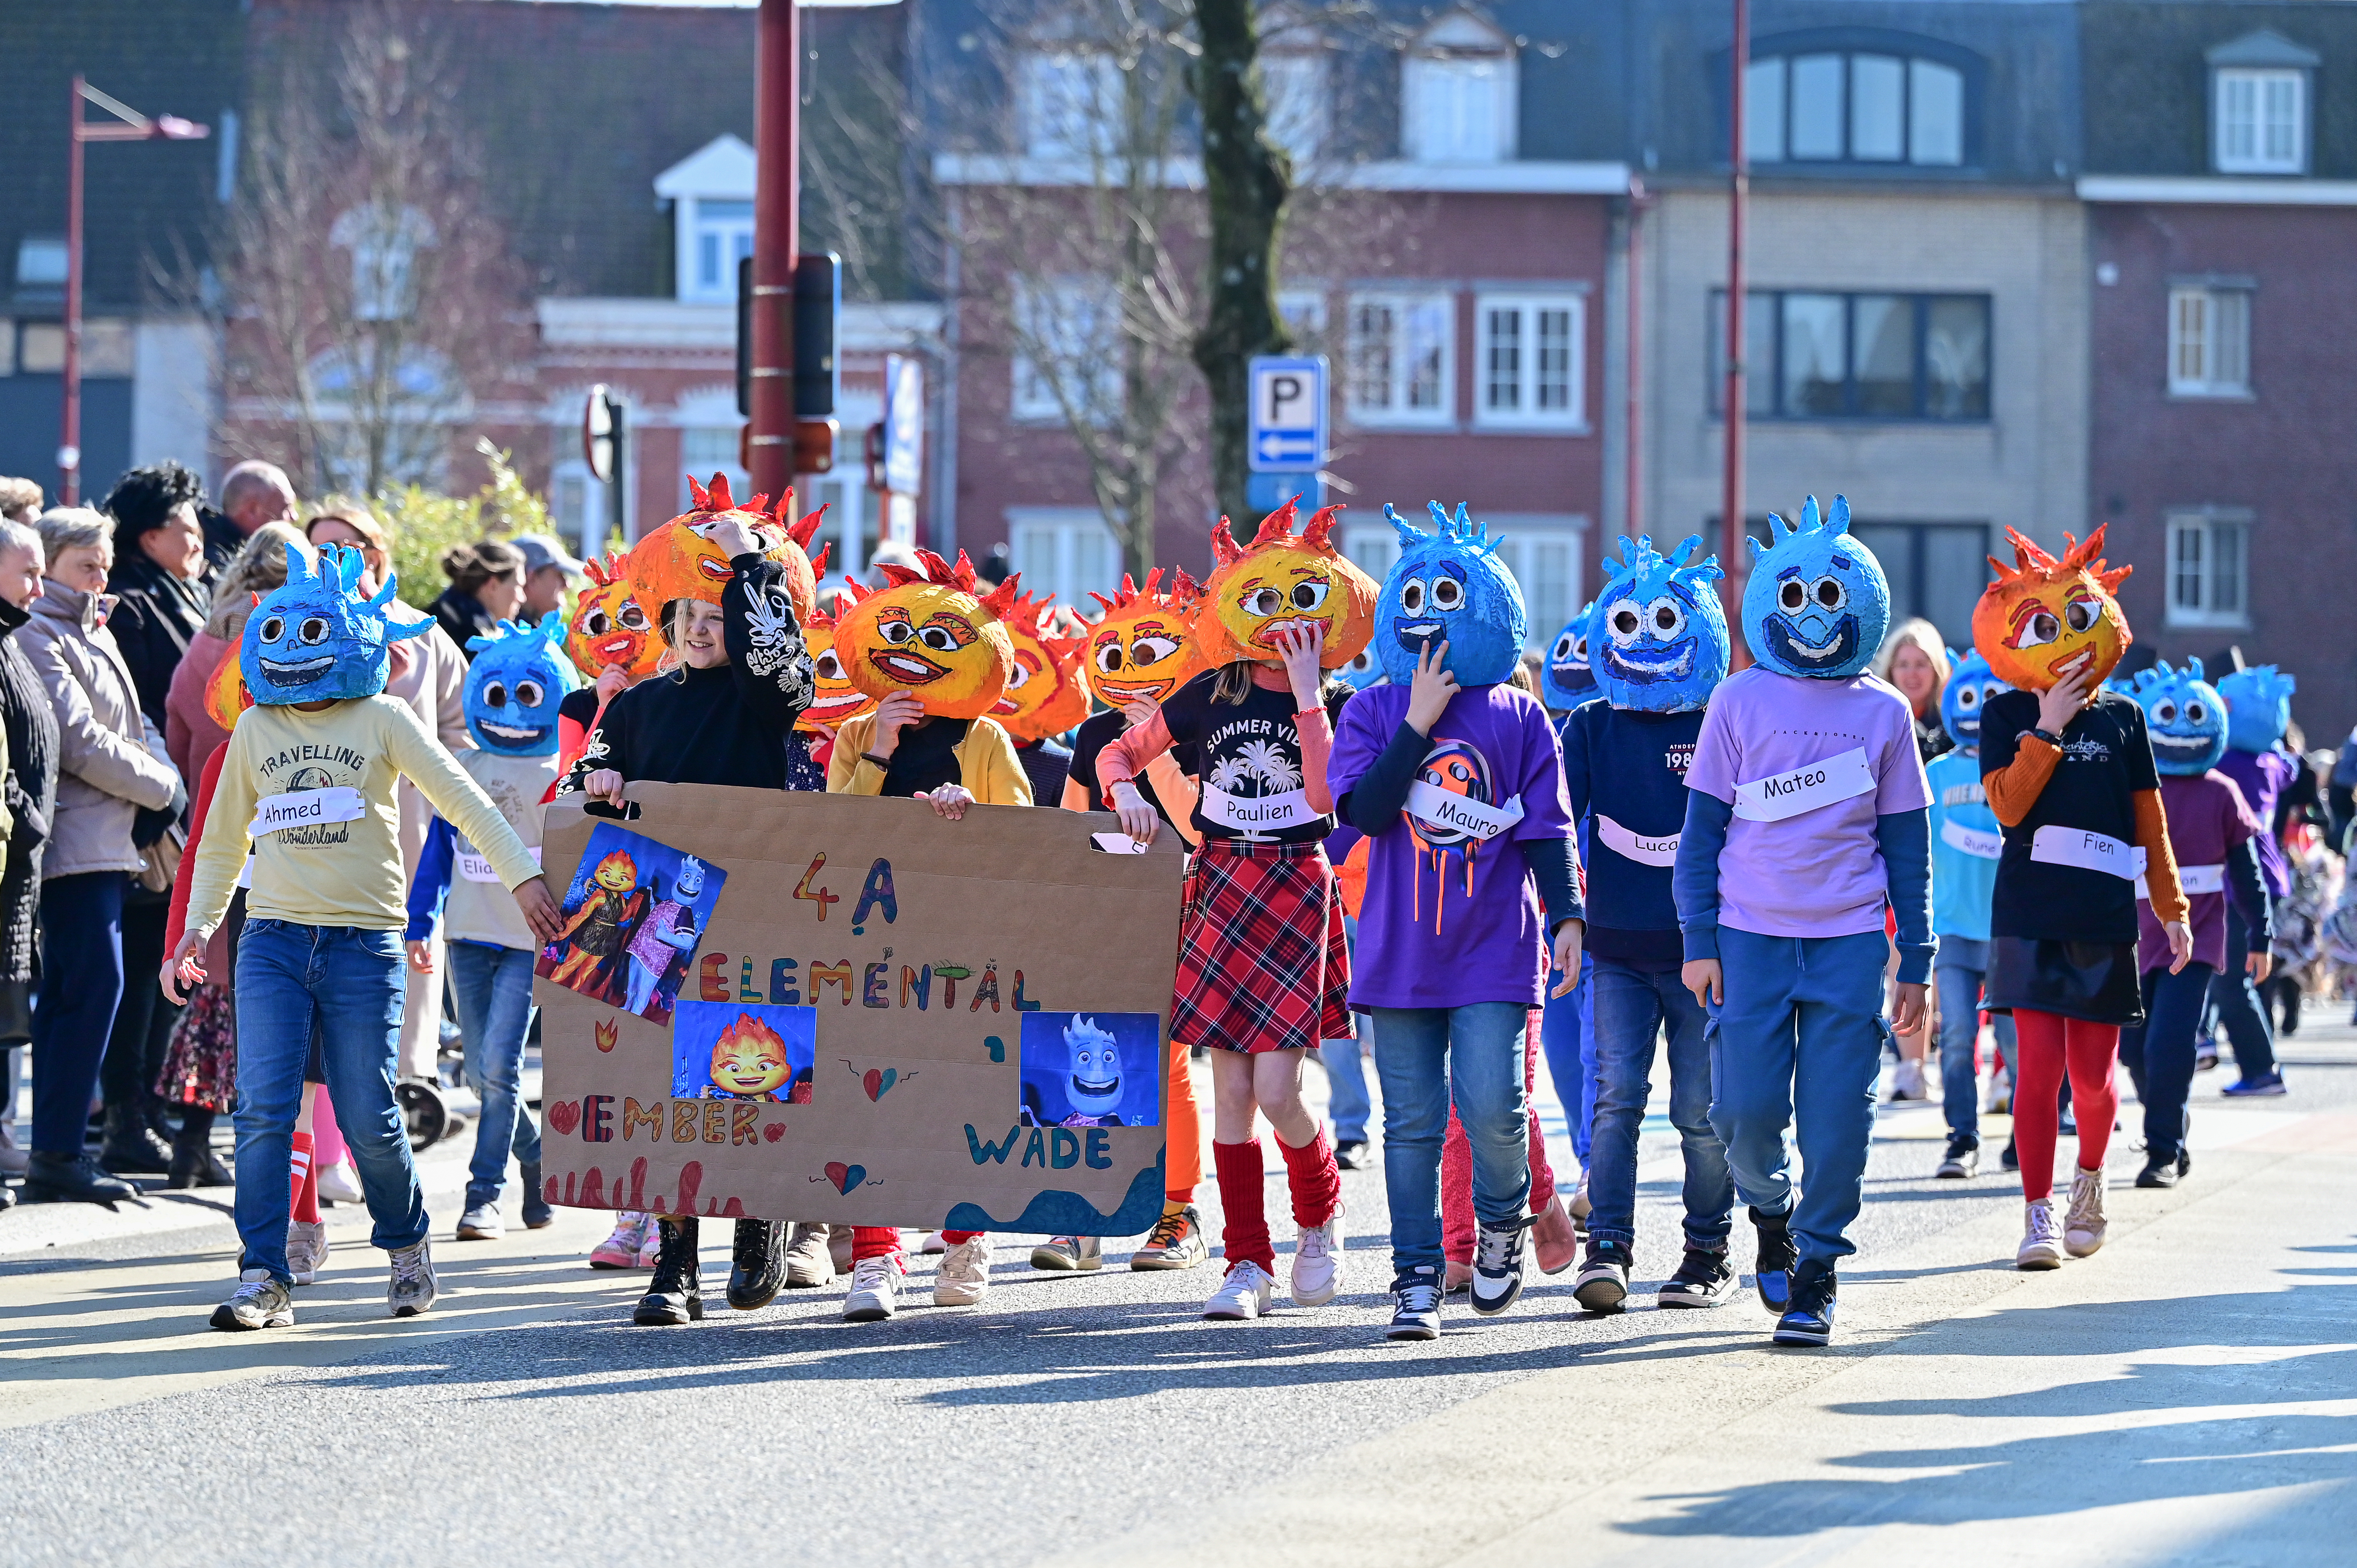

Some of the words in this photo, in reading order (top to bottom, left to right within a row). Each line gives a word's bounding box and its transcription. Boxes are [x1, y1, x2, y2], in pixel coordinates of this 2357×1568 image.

[1273, 377, 1300, 421] P
[1207, 719, 1272, 754] SUMMER
[1278, 723, 1300, 747] VIB
[260, 745, 365, 779] TRAVELLING
[1665, 752, 1692, 768] 198
[1765, 770, 1825, 799] Mateo
[265, 798, 321, 825] Ahmed
[1228, 801, 1293, 821] Paulien
[1436, 801, 1498, 835] Mauro
[277, 821, 349, 845] Wonderland
[2084, 833, 2113, 855] Fien
[464, 859, 496, 874] Elia
[793, 851, 840, 921] 4
[851, 857, 898, 925] A
[582, 1095, 760, 1146] EMBER
[963, 1123, 1113, 1170] WADE
